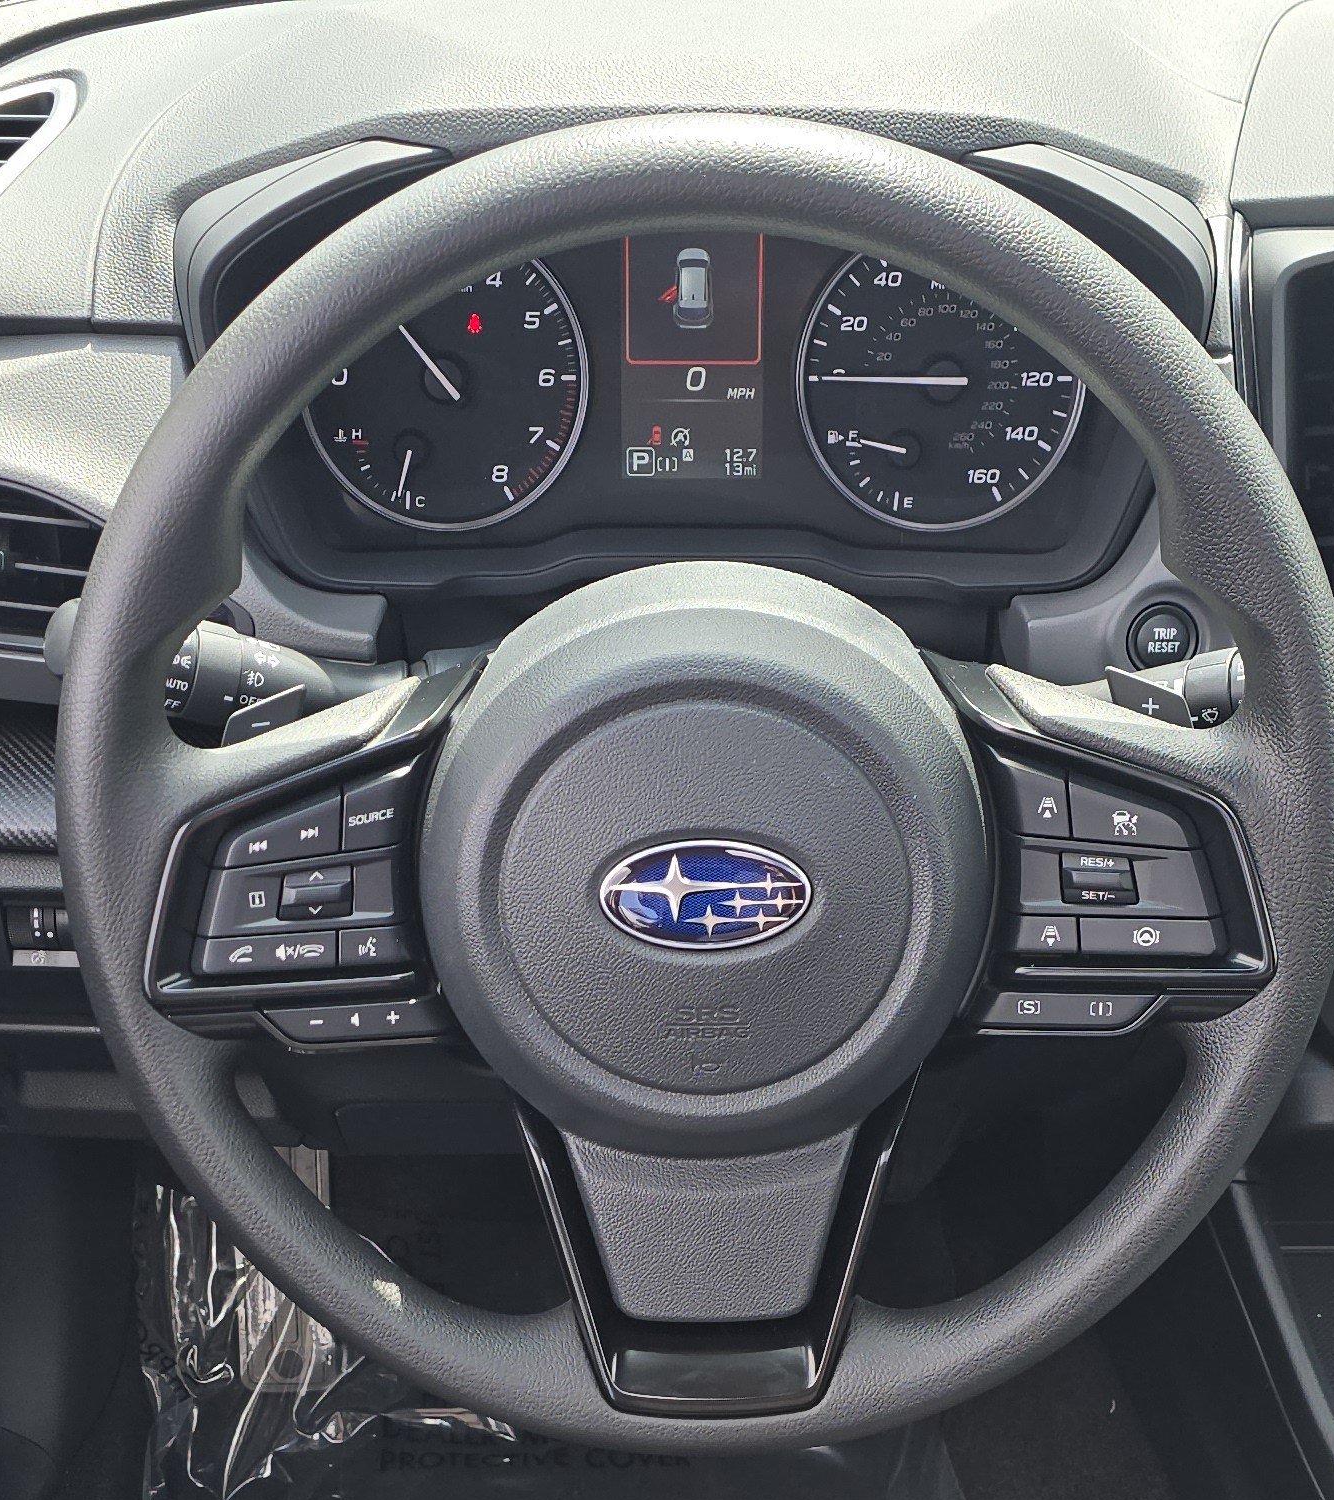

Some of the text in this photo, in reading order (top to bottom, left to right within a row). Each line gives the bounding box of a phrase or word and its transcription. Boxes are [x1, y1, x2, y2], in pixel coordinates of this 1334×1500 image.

[485, 270, 503, 288] 4
[873, 271, 903, 288] 40
[917, 307, 934, 317] 80
[937, 304, 957, 314] 100
[959, 309, 978, 319] 120
[523, 311, 541, 329] 5
[840, 316, 868, 332] 20
[900, 318, 917, 327] 60
[976, 322, 995, 332] 140
[886, 332, 902, 342] 40
[984, 340, 1004, 349] 160
[876, 352, 892, 362] 20
[990, 360, 1010, 369] 180
[538, 369, 556, 387] 6
[686, 366, 707, 391] 0
[1020, 372, 1054, 387] 120
[987, 381, 1010, 391] 200
[727, 387, 756, 400] MPH
[981, 402, 1003, 411] 220
[970, 421, 993, 430] 240
[351, 429, 362, 440] H
[528, 426, 544, 443] 7
[848, 431, 859, 442] F
[952, 432, 975, 442] 260
[1005, 427, 1039, 442] 140
[948, 440, 970, 450] km/h
[632, 452, 650, 472] P
[725, 449, 757, 462] 12.7
[491, 465, 509, 483] 8
[967, 469, 1001, 484] 160
[415, 496, 426, 508] C
[903, 497, 914, 508] E
[1153, 627, 1178, 640] TRIP
[1147, 641, 1181, 654] RESET
[348, 807, 395, 827] SOURCE
[675, 1006, 741, 1024] SRS
[663, 1027, 750, 1041] AIRBAG
